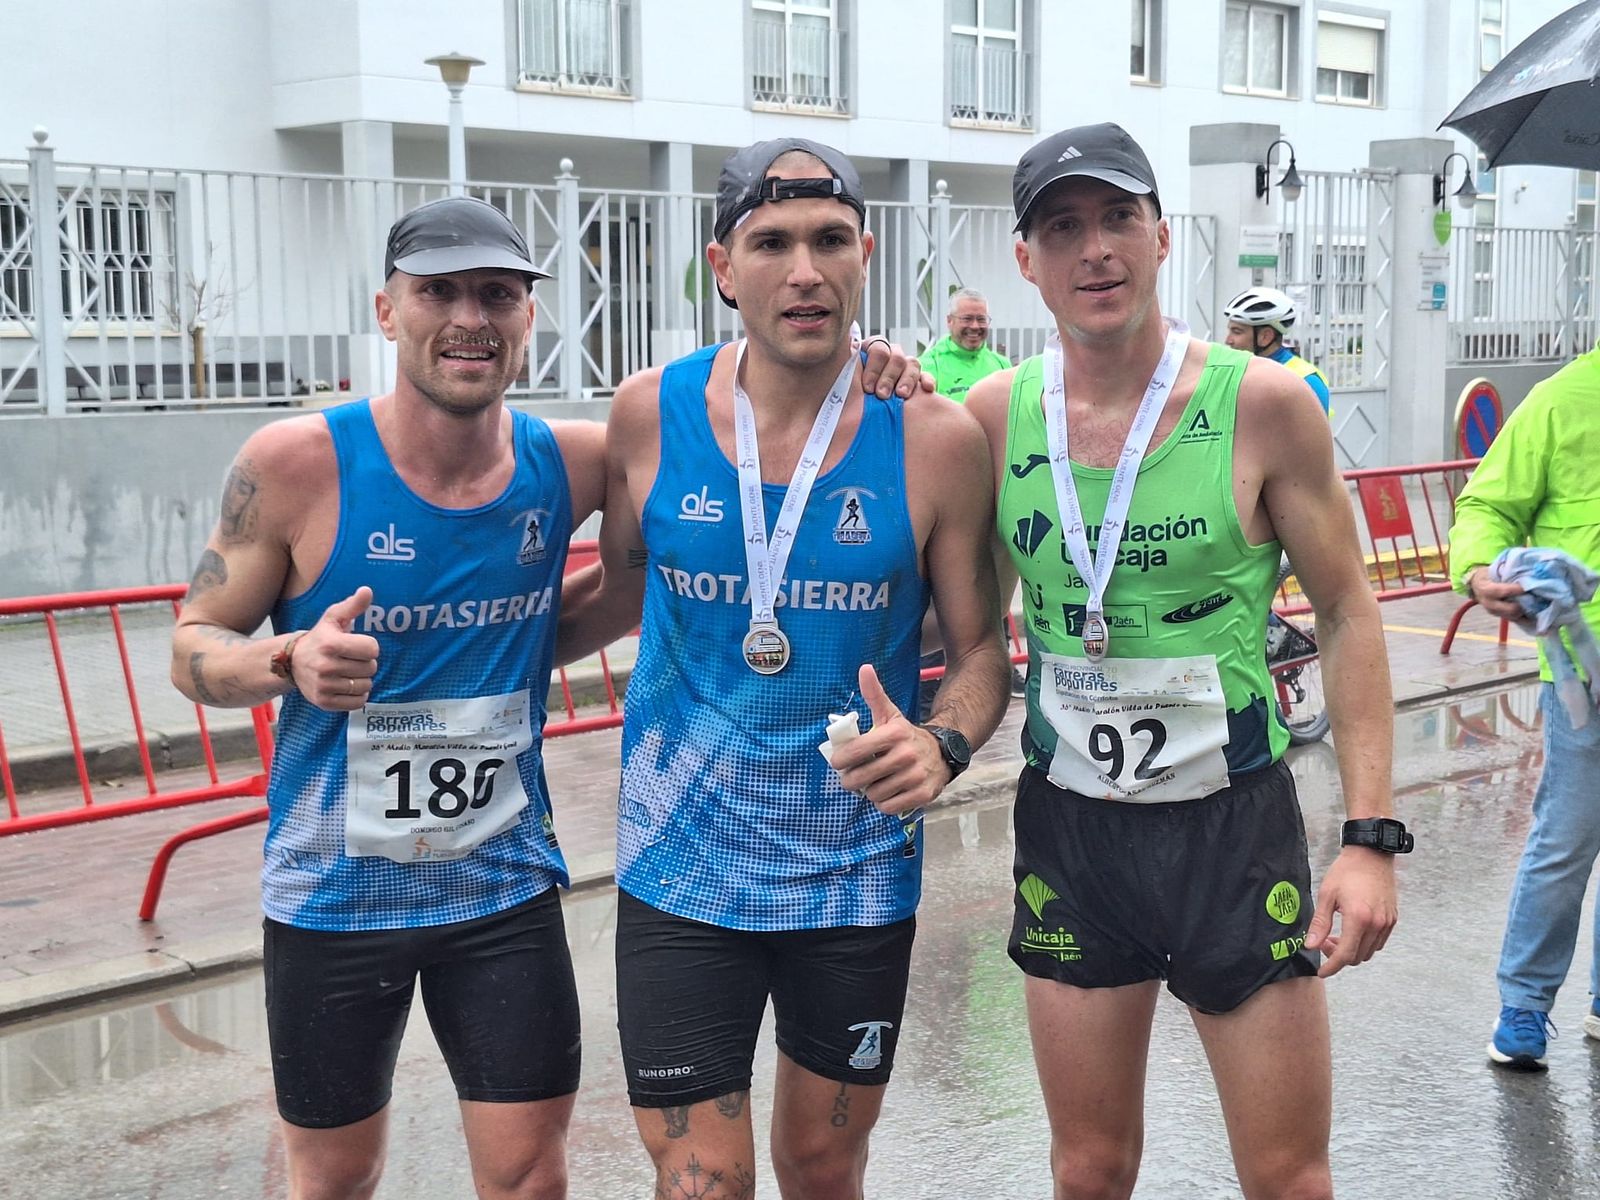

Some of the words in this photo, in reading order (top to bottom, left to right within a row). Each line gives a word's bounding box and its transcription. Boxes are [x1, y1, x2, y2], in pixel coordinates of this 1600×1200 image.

[1054, 667, 1104, 682] carreras
[1055, 676, 1117, 691] populares
[1121, 704, 1141, 712] Villa
[1143, 703, 1153, 711] de
[367, 713, 434, 725] carreras
[367, 722, 447, 733] populares
[1089, 718, 1173, 781] 92
[385, 757, 505, 819] 180
[1026, 926, 1074, 947] Unicaja
